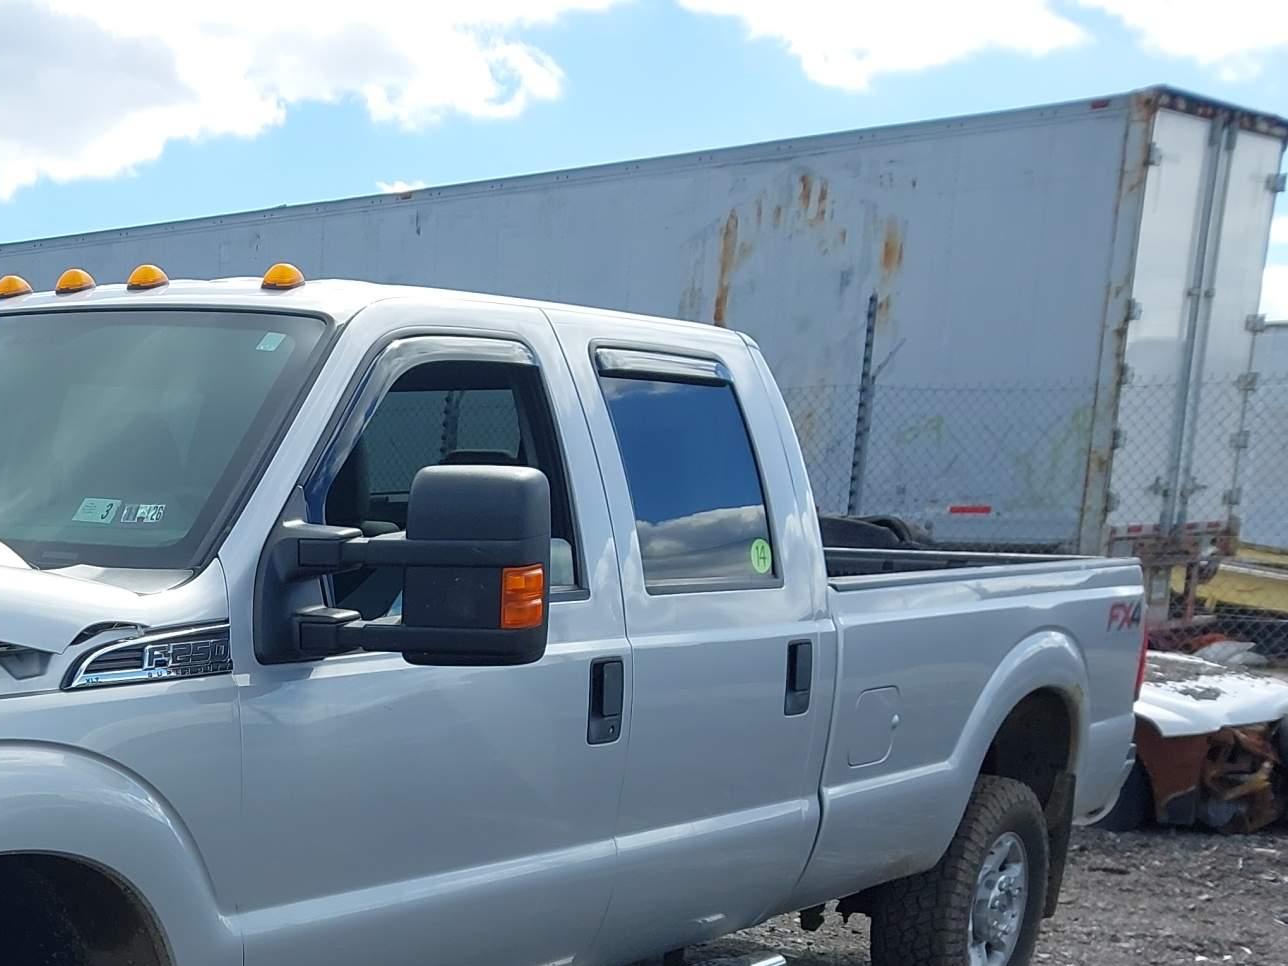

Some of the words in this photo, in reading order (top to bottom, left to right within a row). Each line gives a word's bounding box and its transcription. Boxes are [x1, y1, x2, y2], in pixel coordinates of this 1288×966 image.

[101, 503, 113, 519] 3
[756, 545, 767, 568] 14
[1106, 601, 1141, 632] FX4
